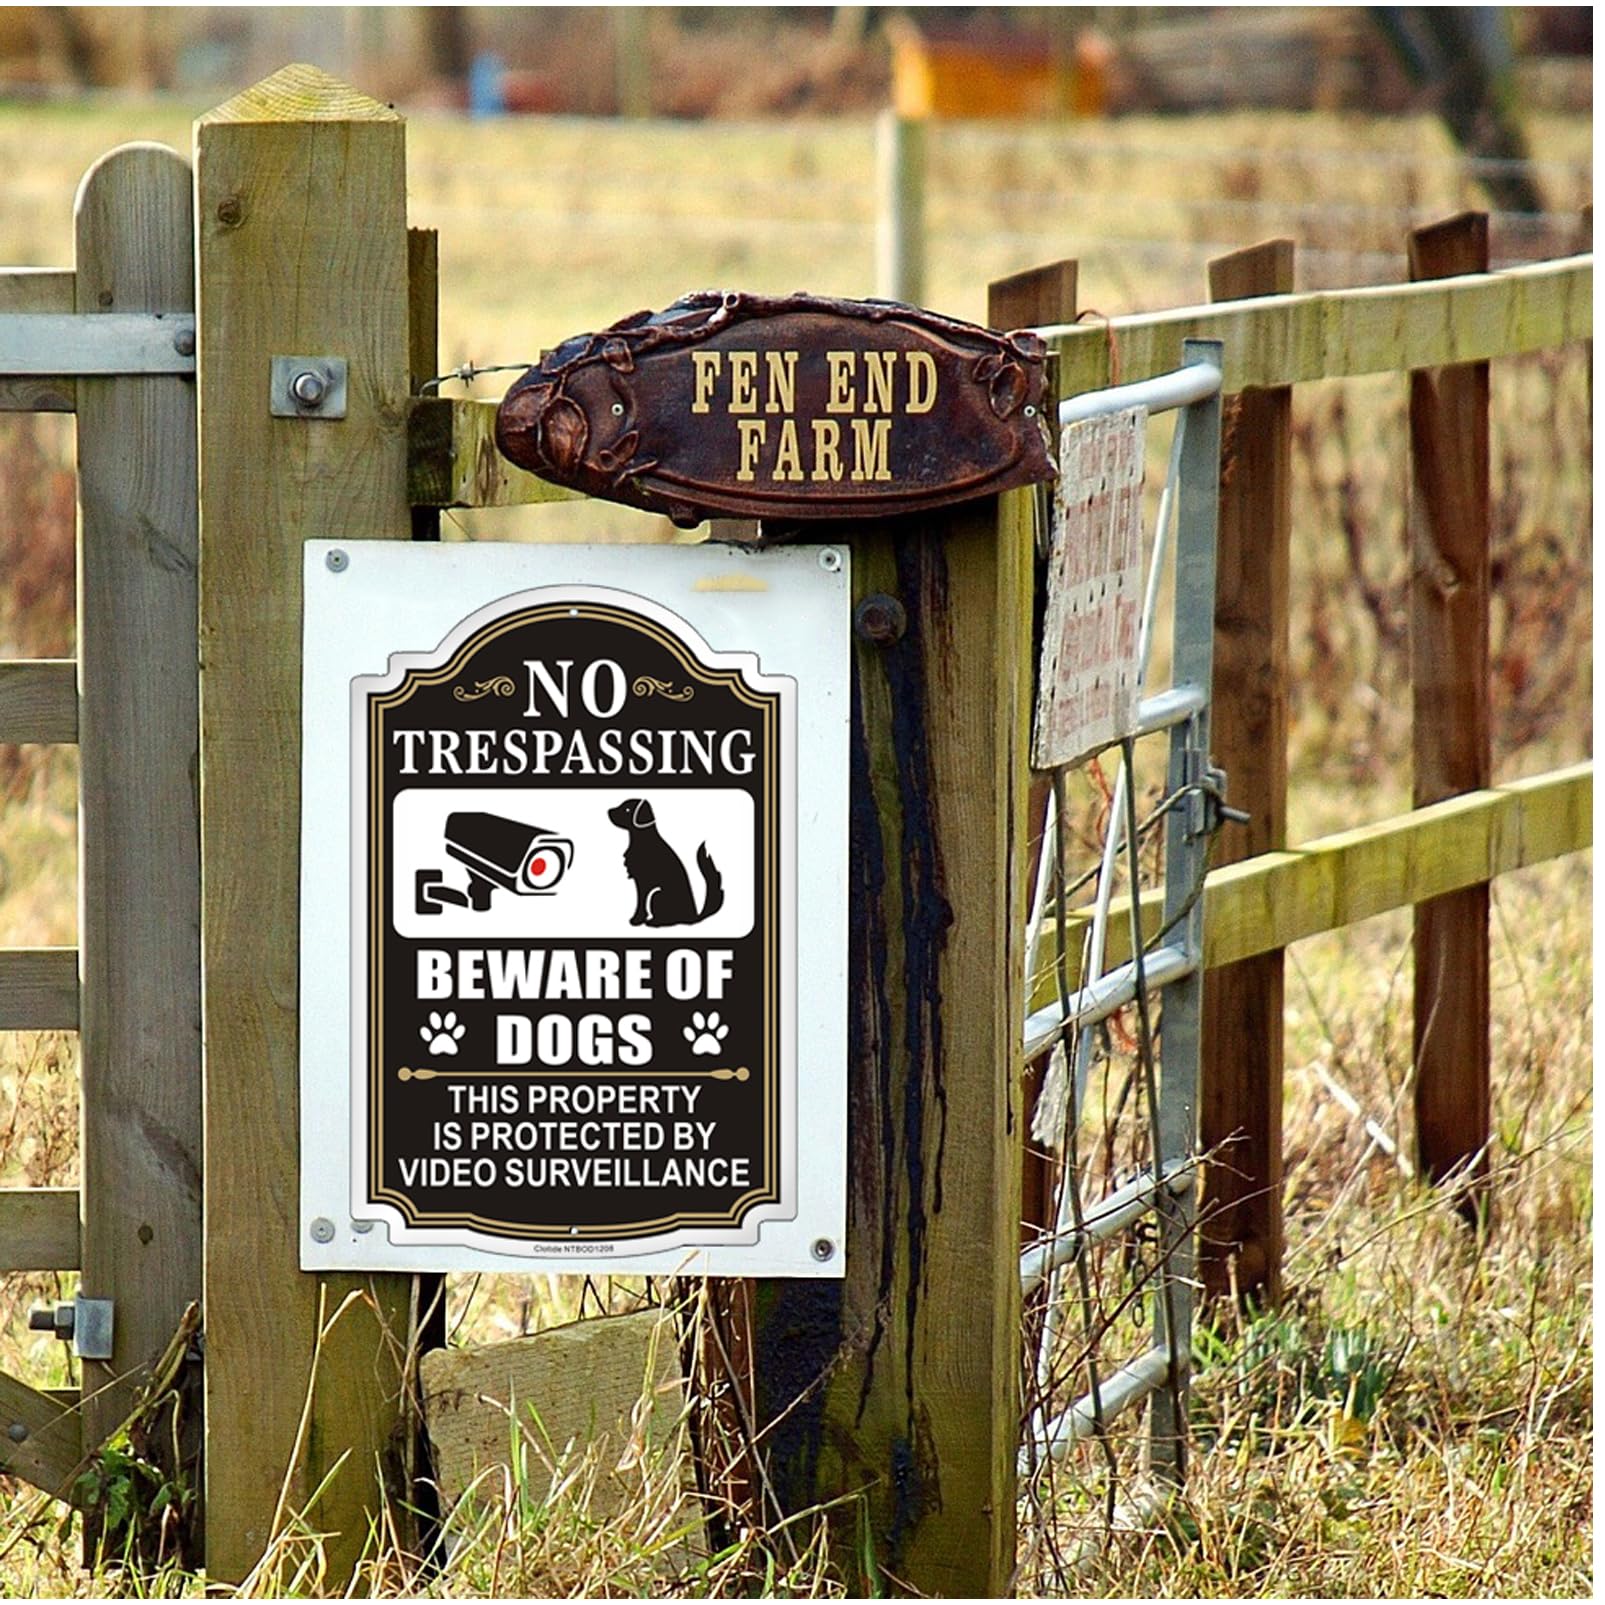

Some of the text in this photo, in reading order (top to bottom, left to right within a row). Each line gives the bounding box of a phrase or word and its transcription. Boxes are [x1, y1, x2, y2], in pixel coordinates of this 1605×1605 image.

[693, 352, 936, 413] FEN END
[737, 420, 891, 481] FARM
[523, 660, 626, 718] NO
[393, 730, 756, 774] TRESPASSING
[418, 949, 733, 1000] BEWARE OF
[497, 1014, 652, 1065] DOGS
[448, 1085, 701, 1114] THIS PROPERTY
[435, 1122, 716, 1150] IS PROTECTED BY
[399, 1158, 749, 1186] VIDEO SURVEILLANCE
